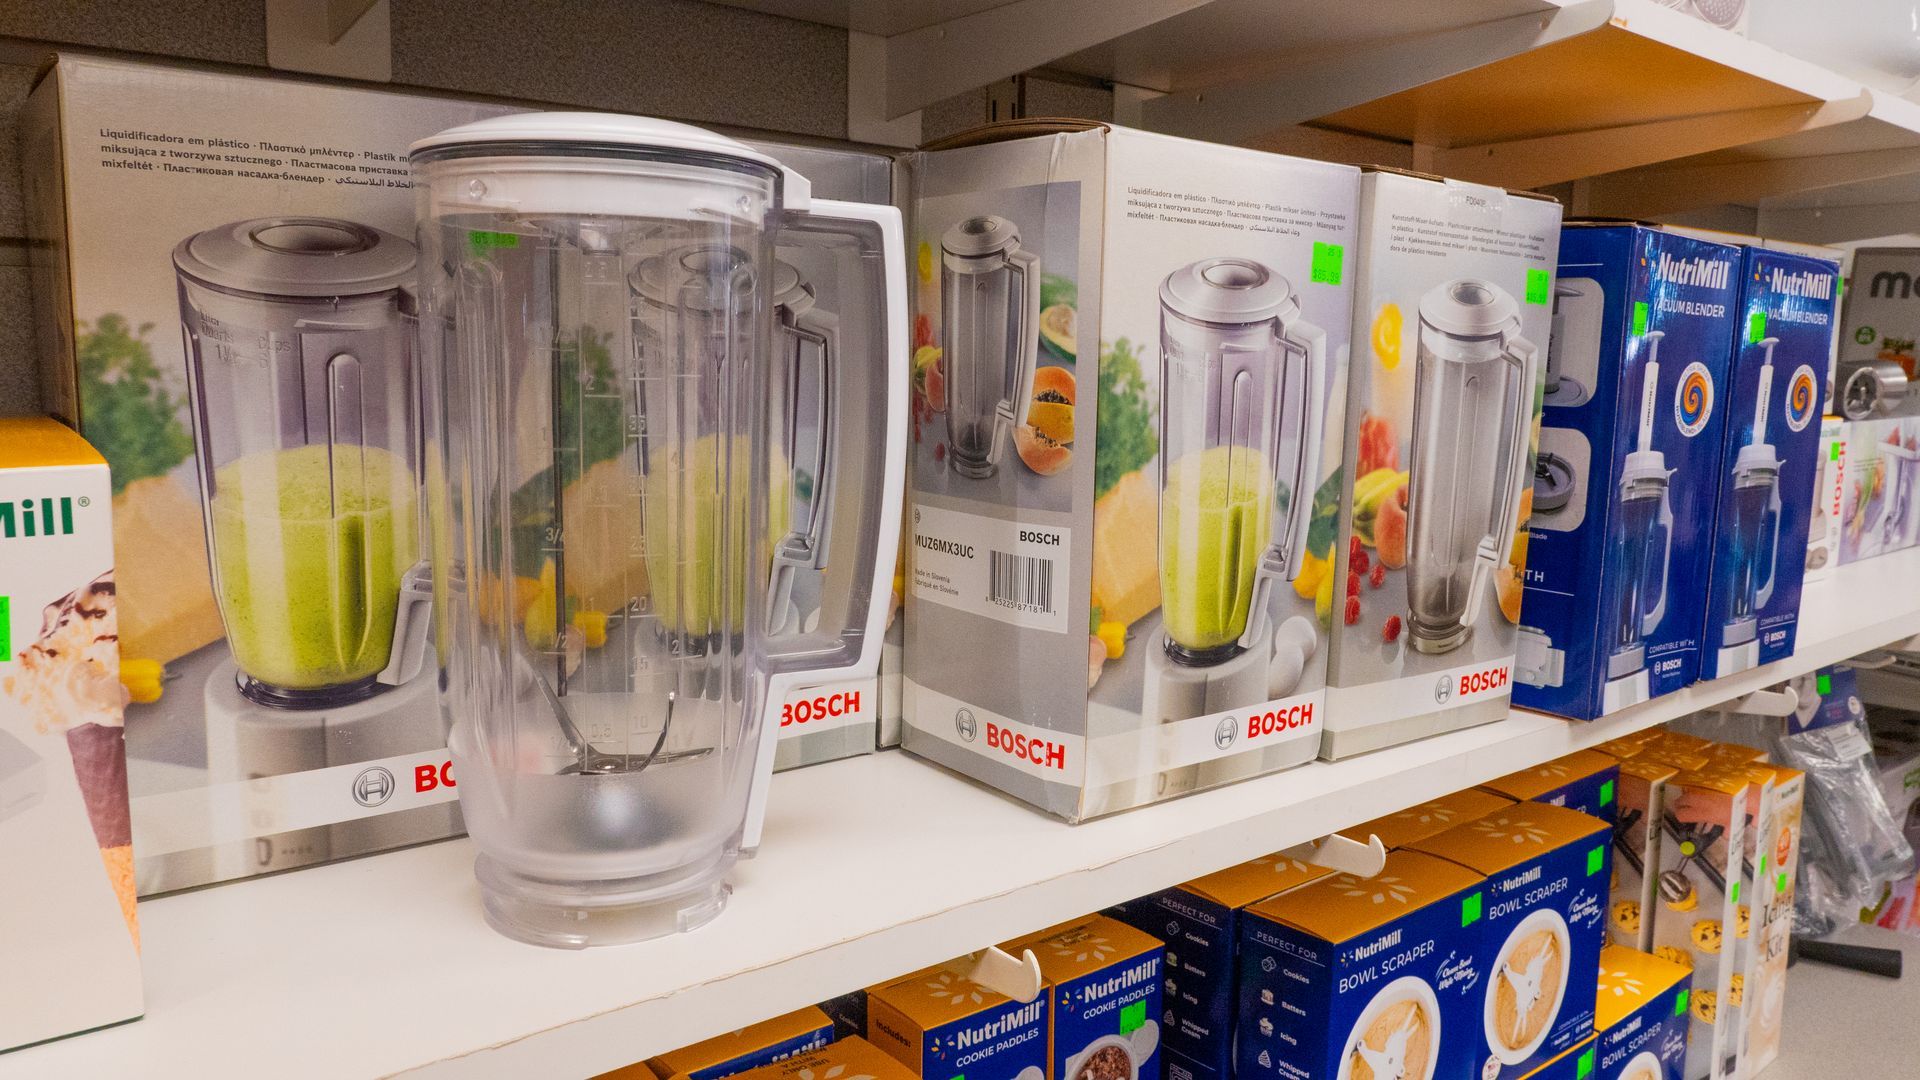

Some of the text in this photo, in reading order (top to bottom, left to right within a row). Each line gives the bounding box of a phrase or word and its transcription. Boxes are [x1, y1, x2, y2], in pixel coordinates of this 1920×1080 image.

[100, 129, 184, 144] Liquidificadora
[209, 139, 250, 149] plástico
[364, 152, 395, 162] Plastik
[101, 145, 157, 157] miksująca
[170, 150, 221, 161] tworzywa
[225, 154, 282, 168] sztucznego
[291, 159, 356, 172] Пластмасова
[102, 159, 153, 171] mixfeltét
[1656, 252, 1729, 290] NutriMill
[1771, 267, 1832, 300] NutriMill
[1686, 301, 1725, 318] BLENDER
[1833, 442, 1847, 516] BOSCH
[1020, 531, 1060, 546] BOSCH
[631, 596, 647, 612] 20
[1460, 666, 1508, 696] BOSCH
[780, 691, 860, 728] BOSCH
[1248, 703, 1313, 739] BOSCH
[987, 722, 1065, 770] BOSCH
[1503, 866, 1542, 893] NutriMill
[1162, 897, 1216, 925] PERFECT FOR
[1489, 877, 1568, 920] BOWL SCRAPER
[1186, 932, 1209, 947] Cookies
[1257, 931, 1318, 961] PERFECT FOR
[1355, 930, 1401, 962] NutriMill
[1084, 959, 1156, 1004] NutriMill
[1284, 968, 1310, 984] Cookies
[1340, 940, 1435, 994] BOWL SCRAPER
[1083, 984, 1155, 1020] COOKIE PADDLES
[1282, 1001, 1307, 1017] Batters
[957, 1002, 1040, 1050] NutriMill
[1182, 1018, 1209, 1036] Whipped
[1182, 1026, 1201, 1040] Cream
[1280, 1032, 1298, 1046] Icing
[956, 1028, 1039, 1068] COOKIE PADDLES
[1602, 1047, 1627, 1070] BOWL
[1628, 1022, 1662, 1053] SCRAPER
[1279, 1060, 1310, 1079] Whipped
